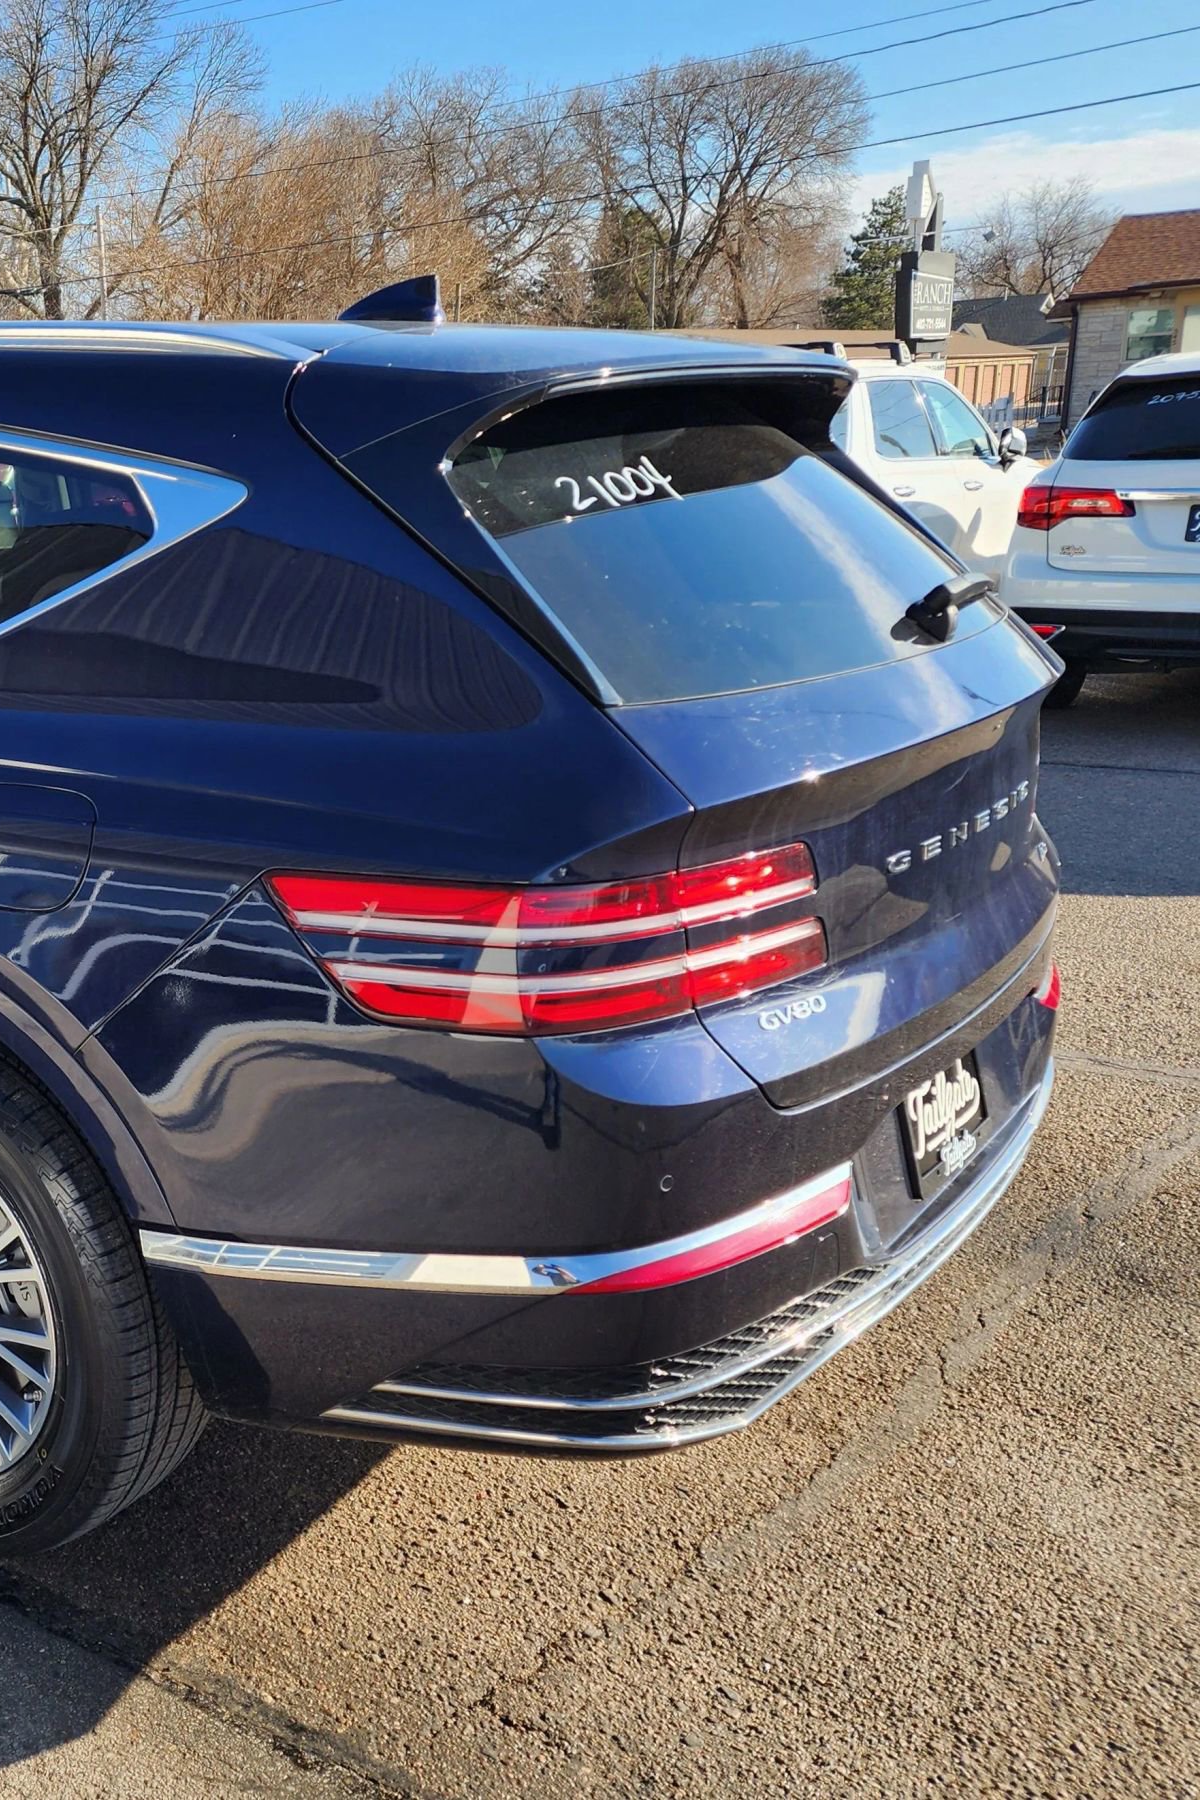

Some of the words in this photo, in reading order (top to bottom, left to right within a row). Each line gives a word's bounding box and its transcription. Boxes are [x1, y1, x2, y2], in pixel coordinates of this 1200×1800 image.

[916, 282, 952, 304] RANCH
[554, 455, 685, 511] 21004
[886, 780, 1030, 875] GENESIS
[759, 995, 827, 1031] GV80
